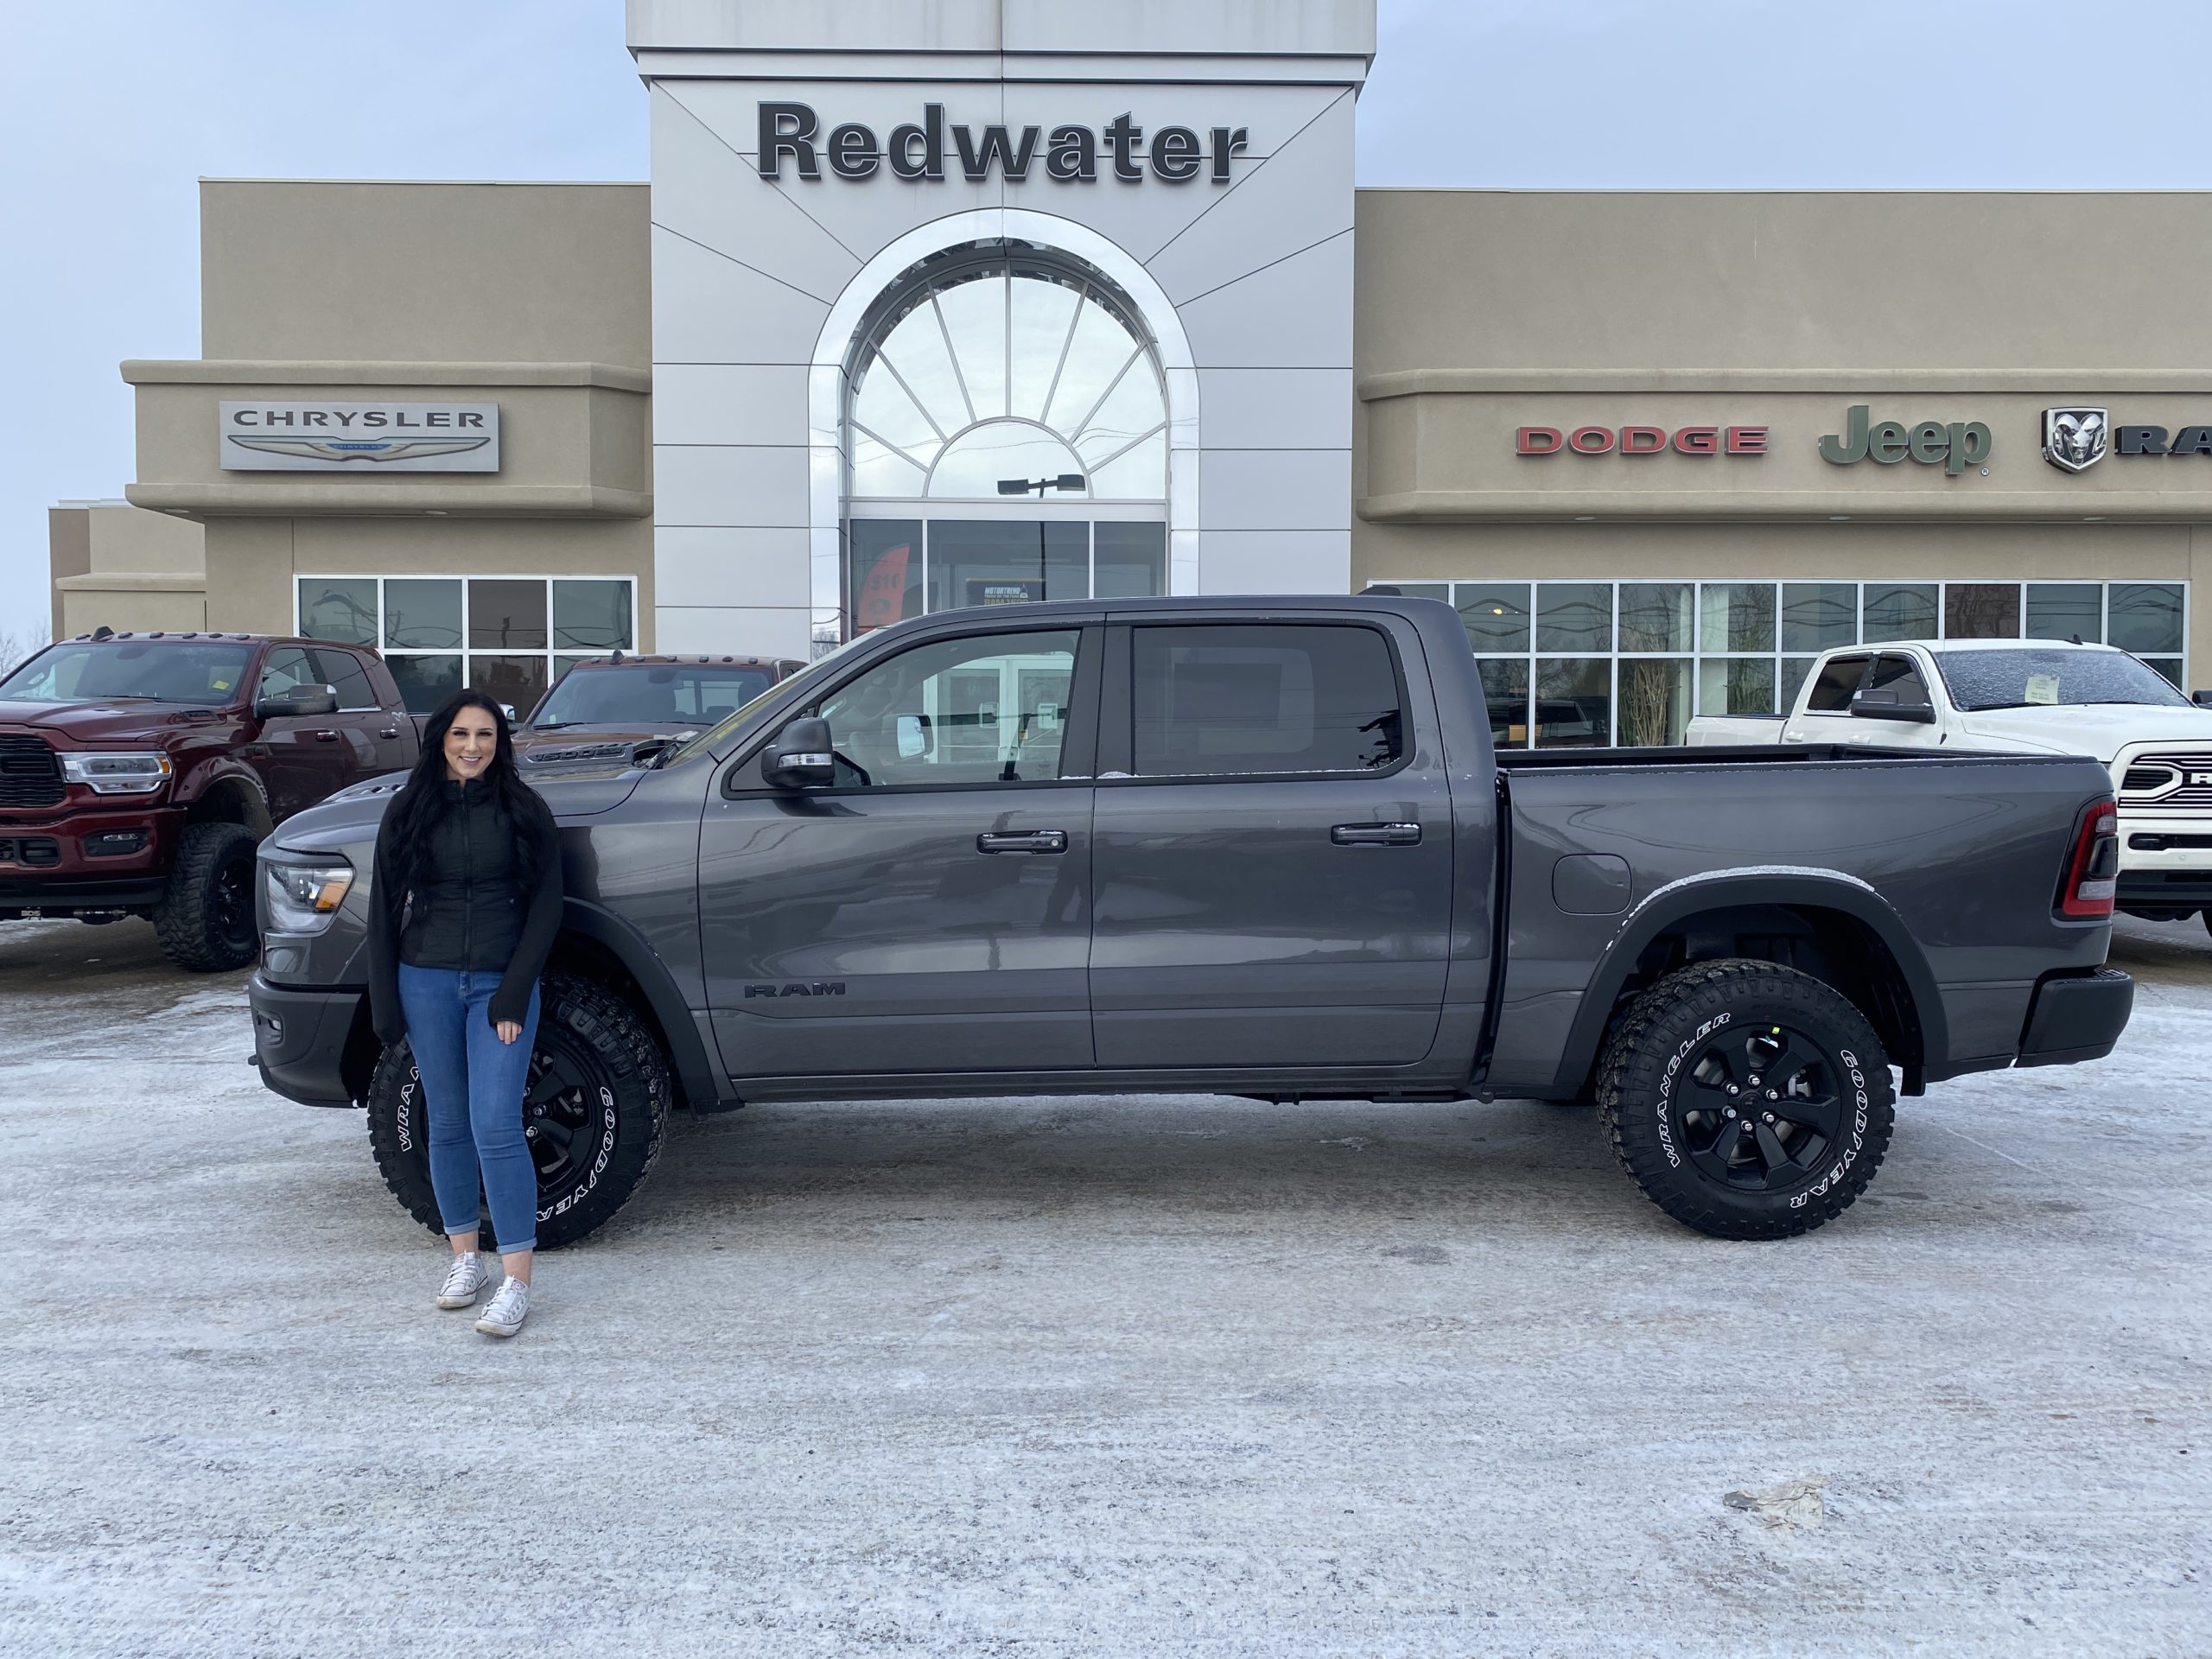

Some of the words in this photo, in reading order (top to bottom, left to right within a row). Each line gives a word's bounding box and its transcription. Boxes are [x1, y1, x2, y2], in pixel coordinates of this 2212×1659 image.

[757, 101, 1249, 182] Redwater
[233, 410, 484, 428] CHRYSLER
[1516, 426, 1770, 456] DODGE
[1819, 405, 1992, 476] Jeep
[744, 982, 846, 998] RAM
[1656, 1012, 1732, 1168] WRANGLER
[1789, 1049, 1868, 1209] GOODYEAR
